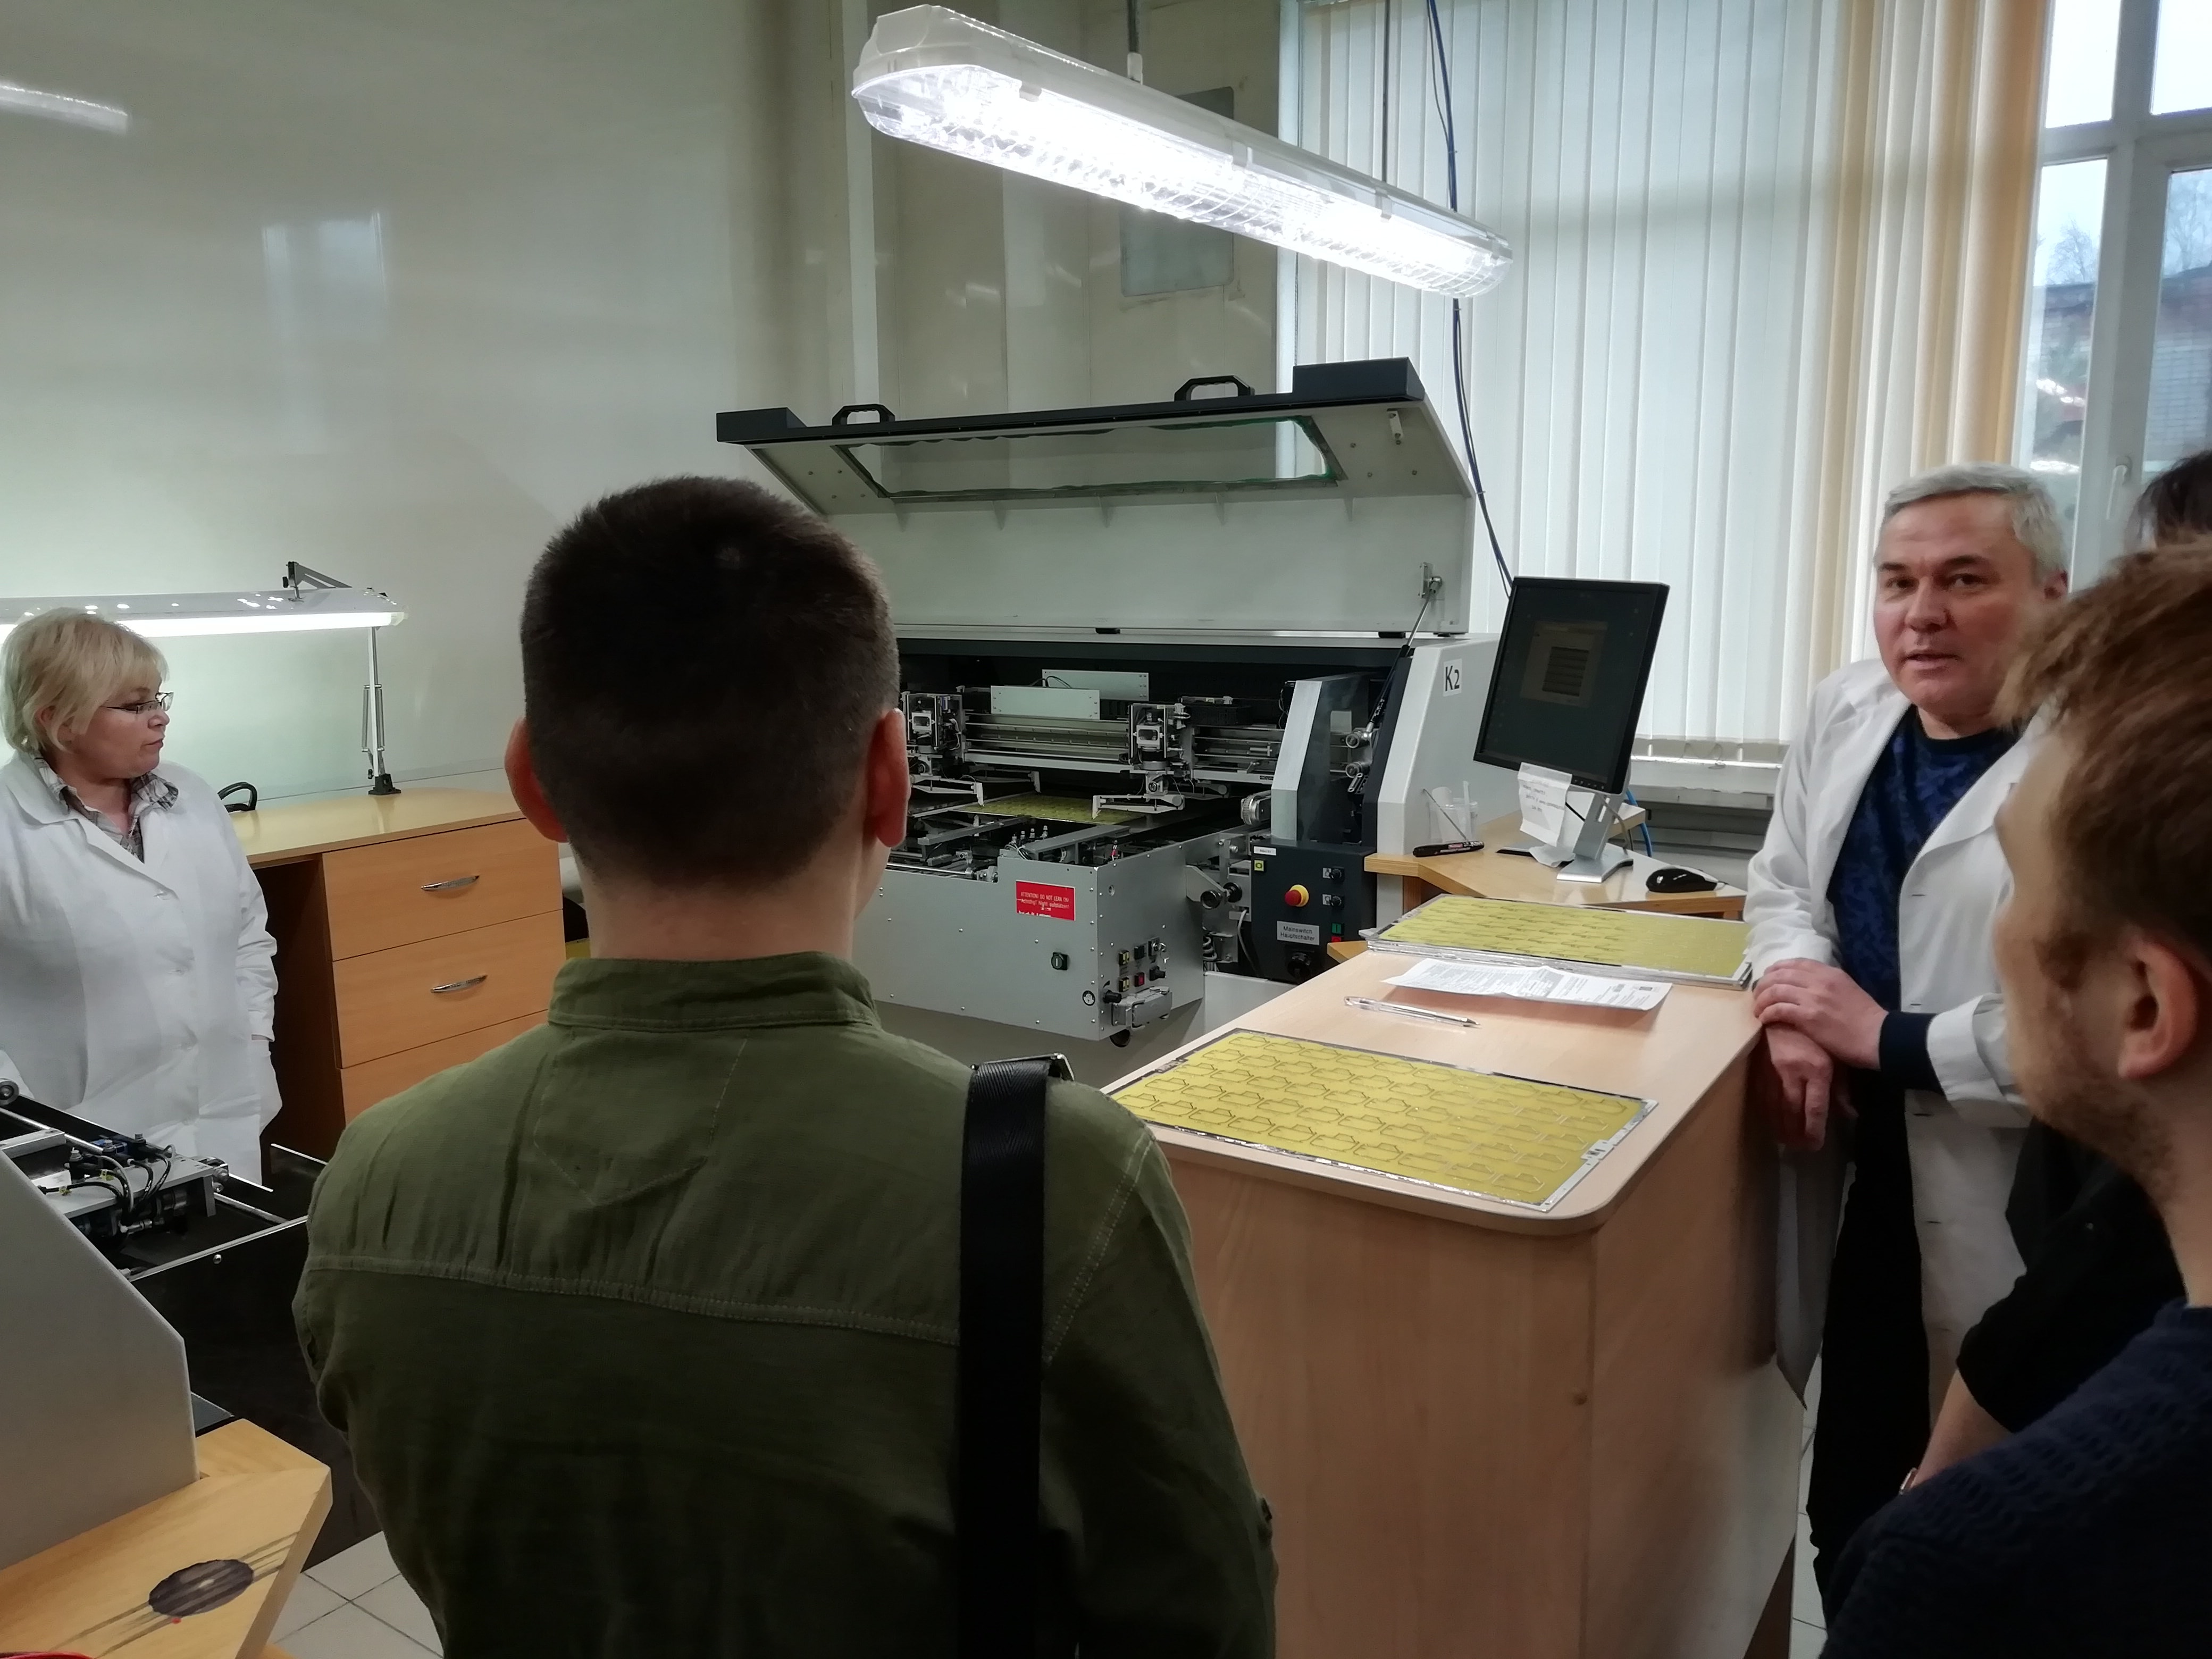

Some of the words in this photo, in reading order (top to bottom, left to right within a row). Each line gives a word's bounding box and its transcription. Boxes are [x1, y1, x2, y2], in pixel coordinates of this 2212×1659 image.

[1445, 665, 1460, 691] K2
[1283, 926, 1313, 934] Mainswitch
[1280, 932, 1315, 941] Hauptschalter
